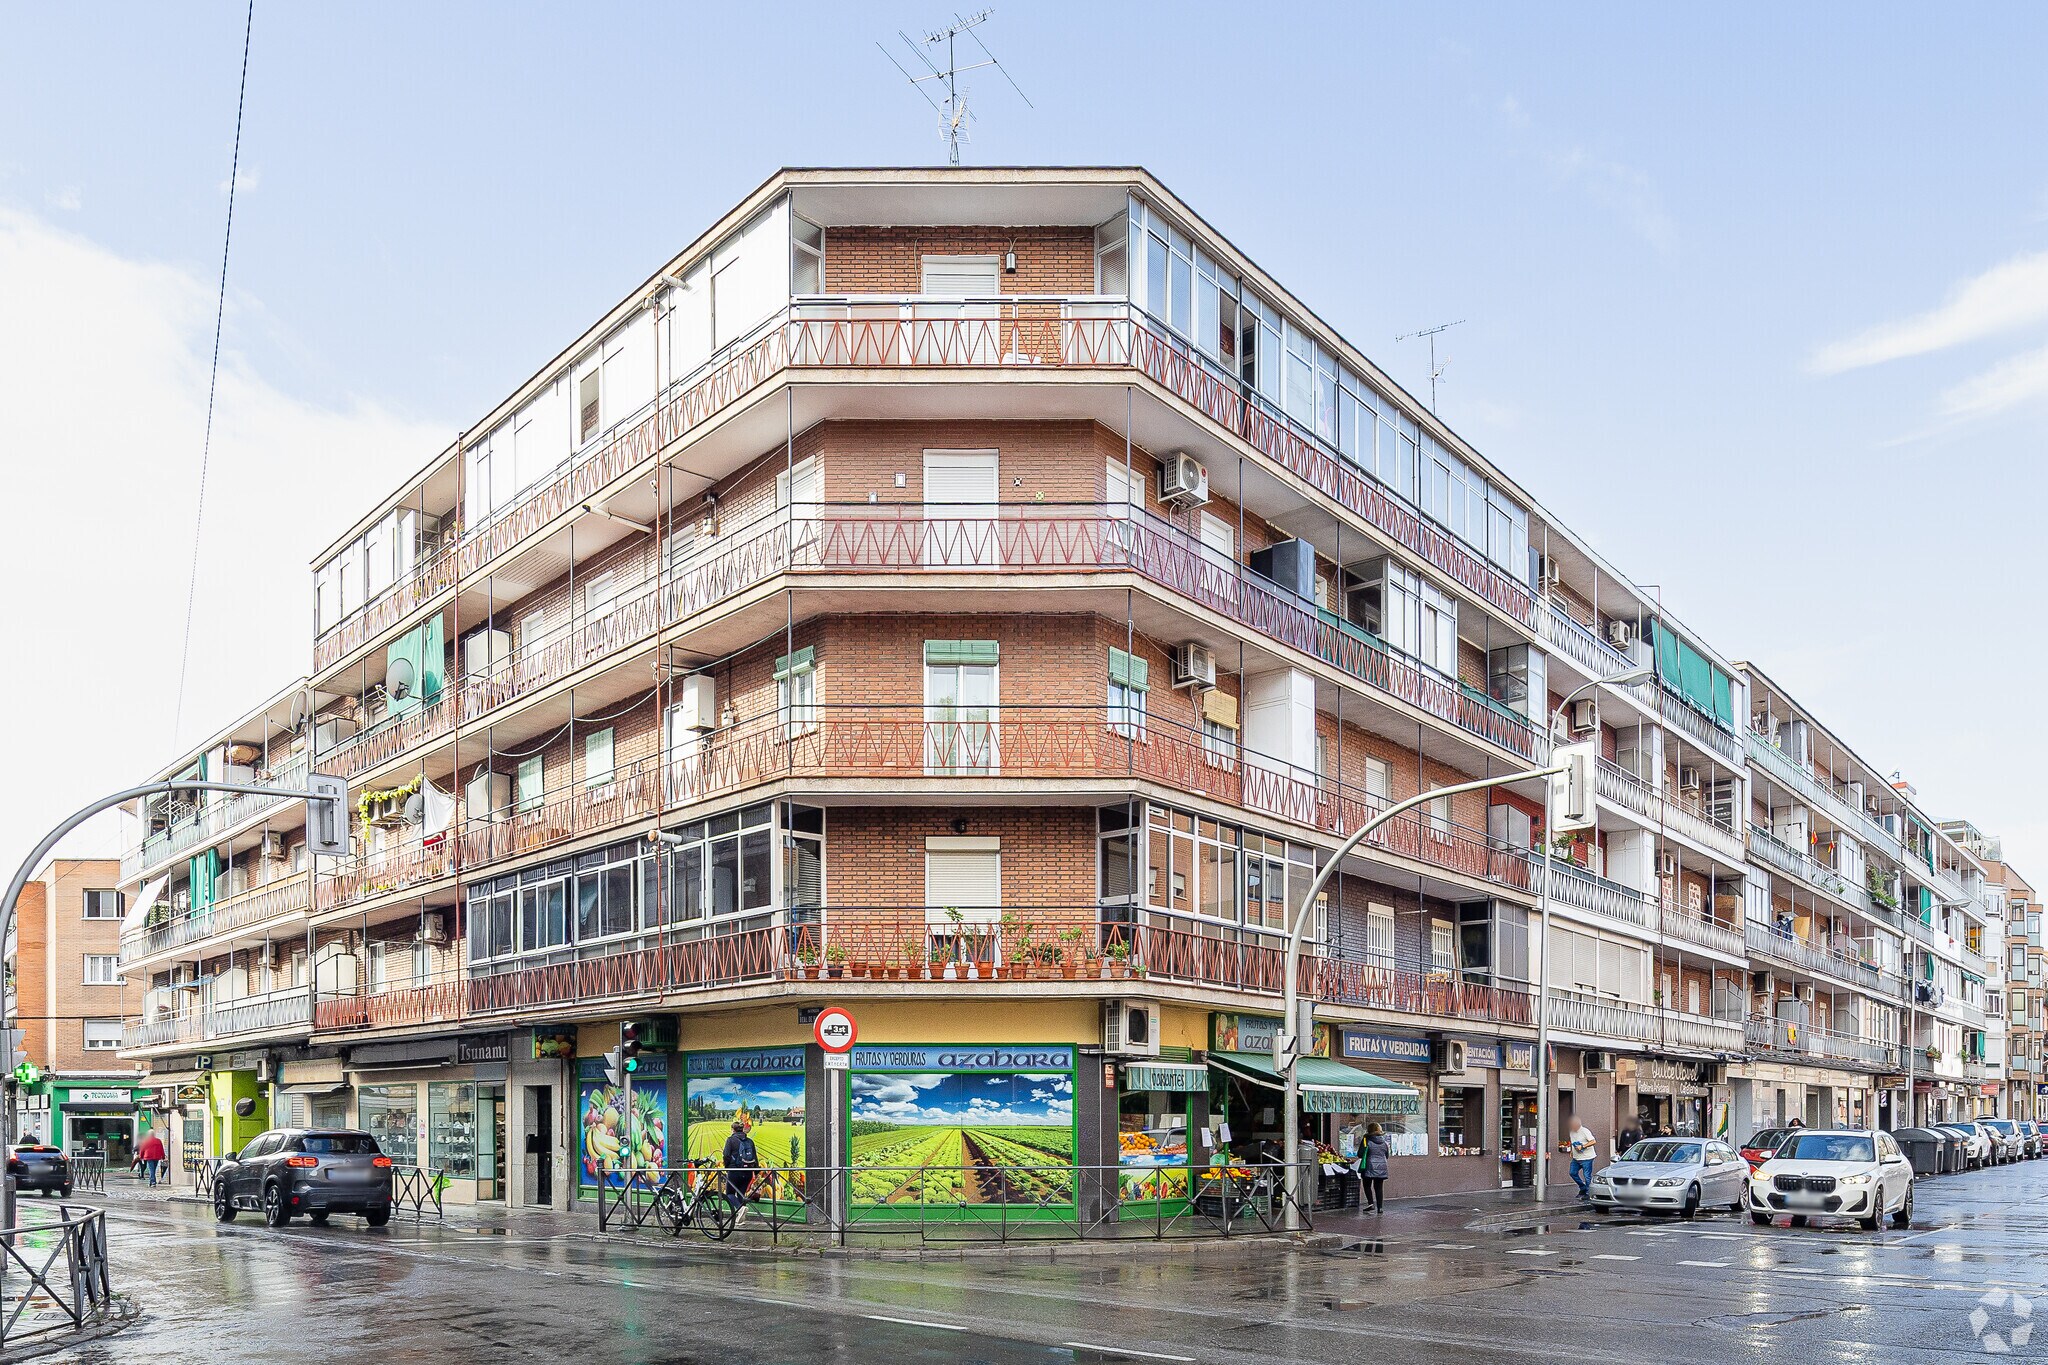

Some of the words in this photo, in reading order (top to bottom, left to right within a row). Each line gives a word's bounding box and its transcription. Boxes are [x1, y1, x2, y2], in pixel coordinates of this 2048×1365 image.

[459, 1043, 507, 1061] Tsunami
[1349, 1036, 1380, 1053] FRUTAS
[1381, 1039, 1388, 1054] Y
[1388, 1040, 1429, 1057] VERDURAS
[201, 1056, 211, 1065] P
[855, 1052, 882, 1066] FRUTAS
[882, 1052, 889, 1066] Y
[889, 1052, 927, 1066] VERDURAS
